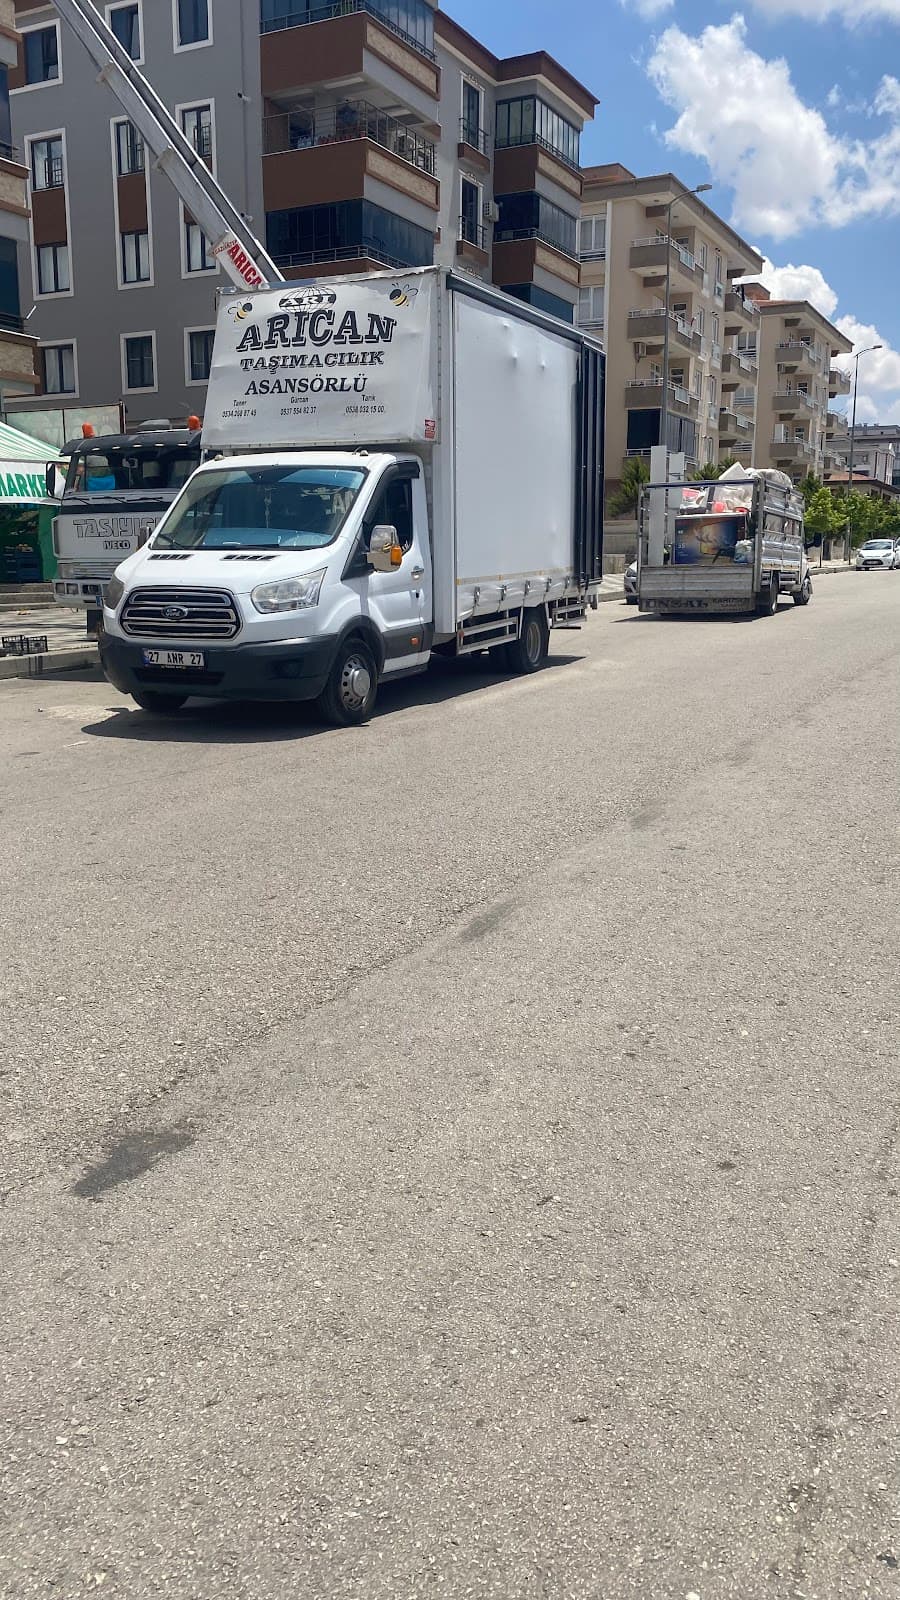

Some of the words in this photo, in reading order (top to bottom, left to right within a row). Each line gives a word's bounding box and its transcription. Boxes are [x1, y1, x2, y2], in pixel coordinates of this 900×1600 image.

[282, 293, 336, 308] ARI
[236, 310, 397, 352] ARICAN
[240, 350, 385, 374] TAŞIMACILIK
[244, 373, 368, 396] ASANSÖRLÜ
[104, 540, 130, 550] IVECO
[148, 651, 159, 663] 27
[167, 652, 184, 664] ANR
[190, 654, 202, 665] 27
